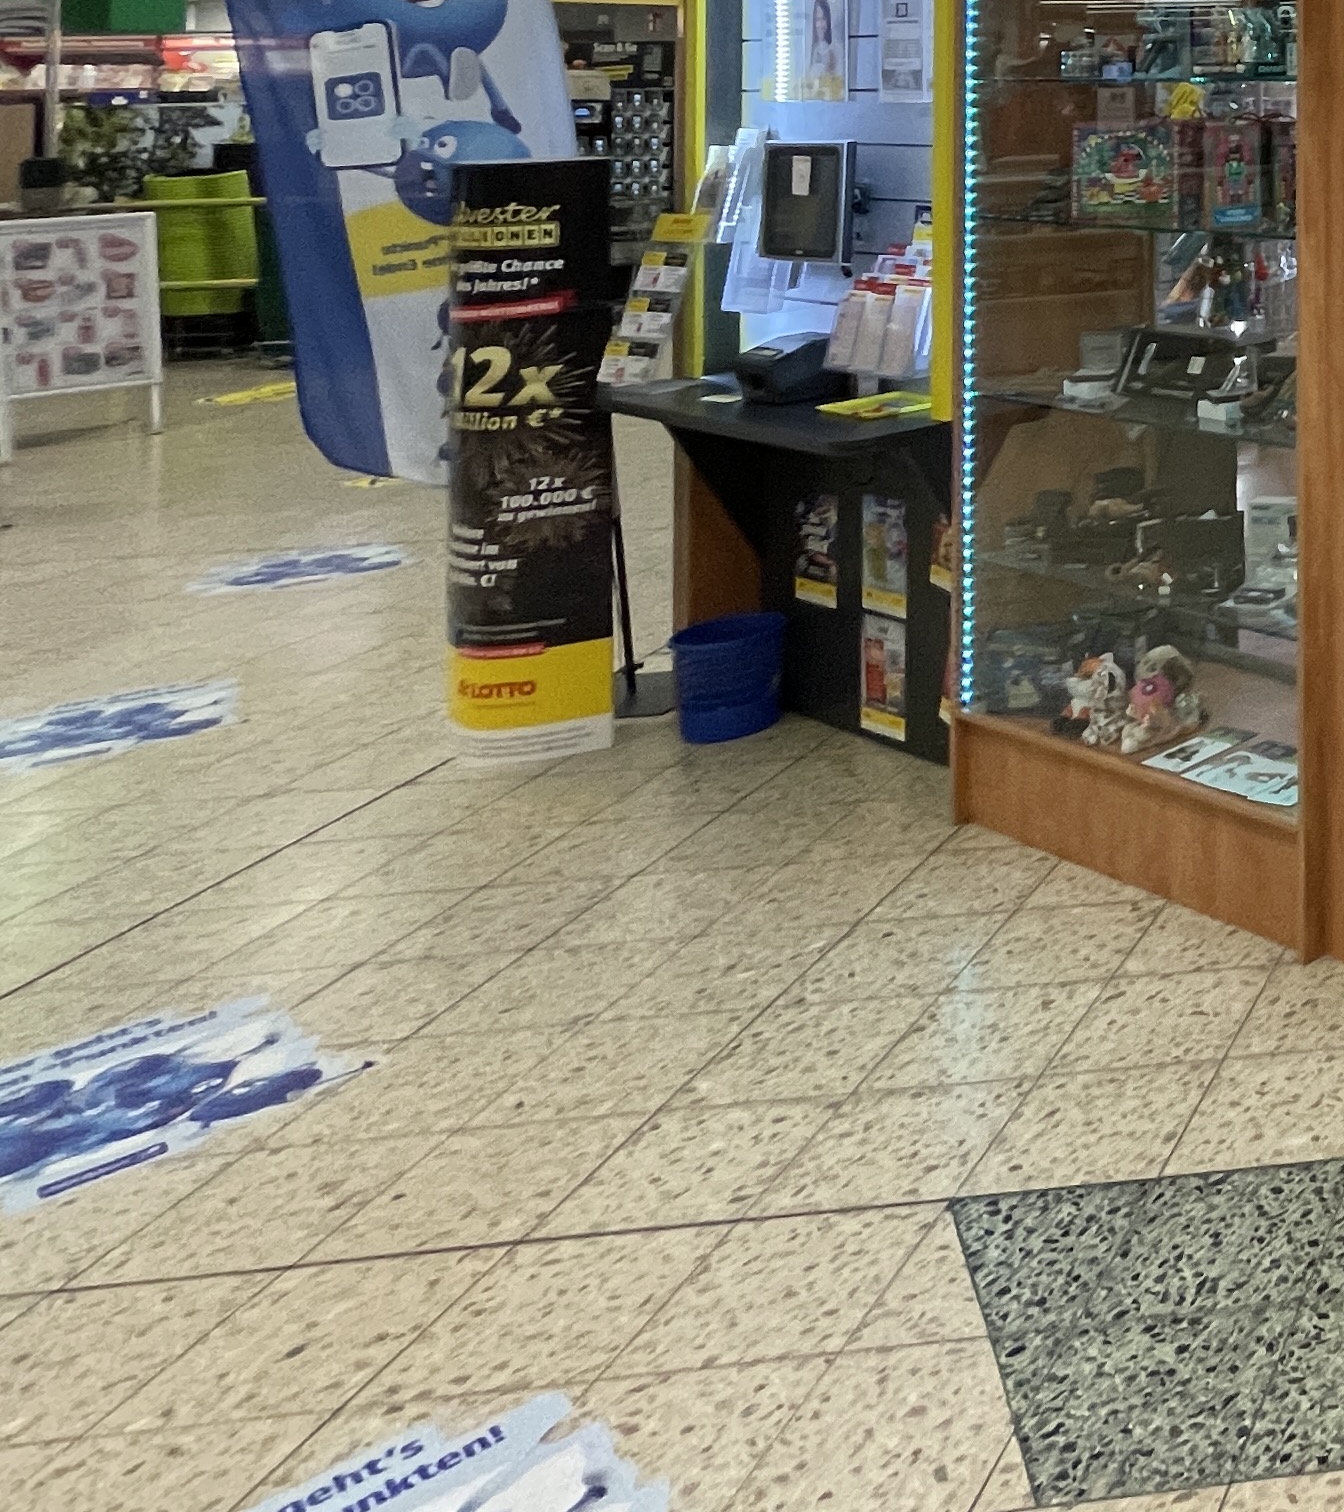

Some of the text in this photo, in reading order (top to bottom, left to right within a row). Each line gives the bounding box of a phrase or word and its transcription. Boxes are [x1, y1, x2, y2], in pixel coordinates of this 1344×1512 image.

[501, 259, 565, 273] Chance
[501, 489, 577, 509] 100.000
[471, 680, 537, 699] LOTTO
